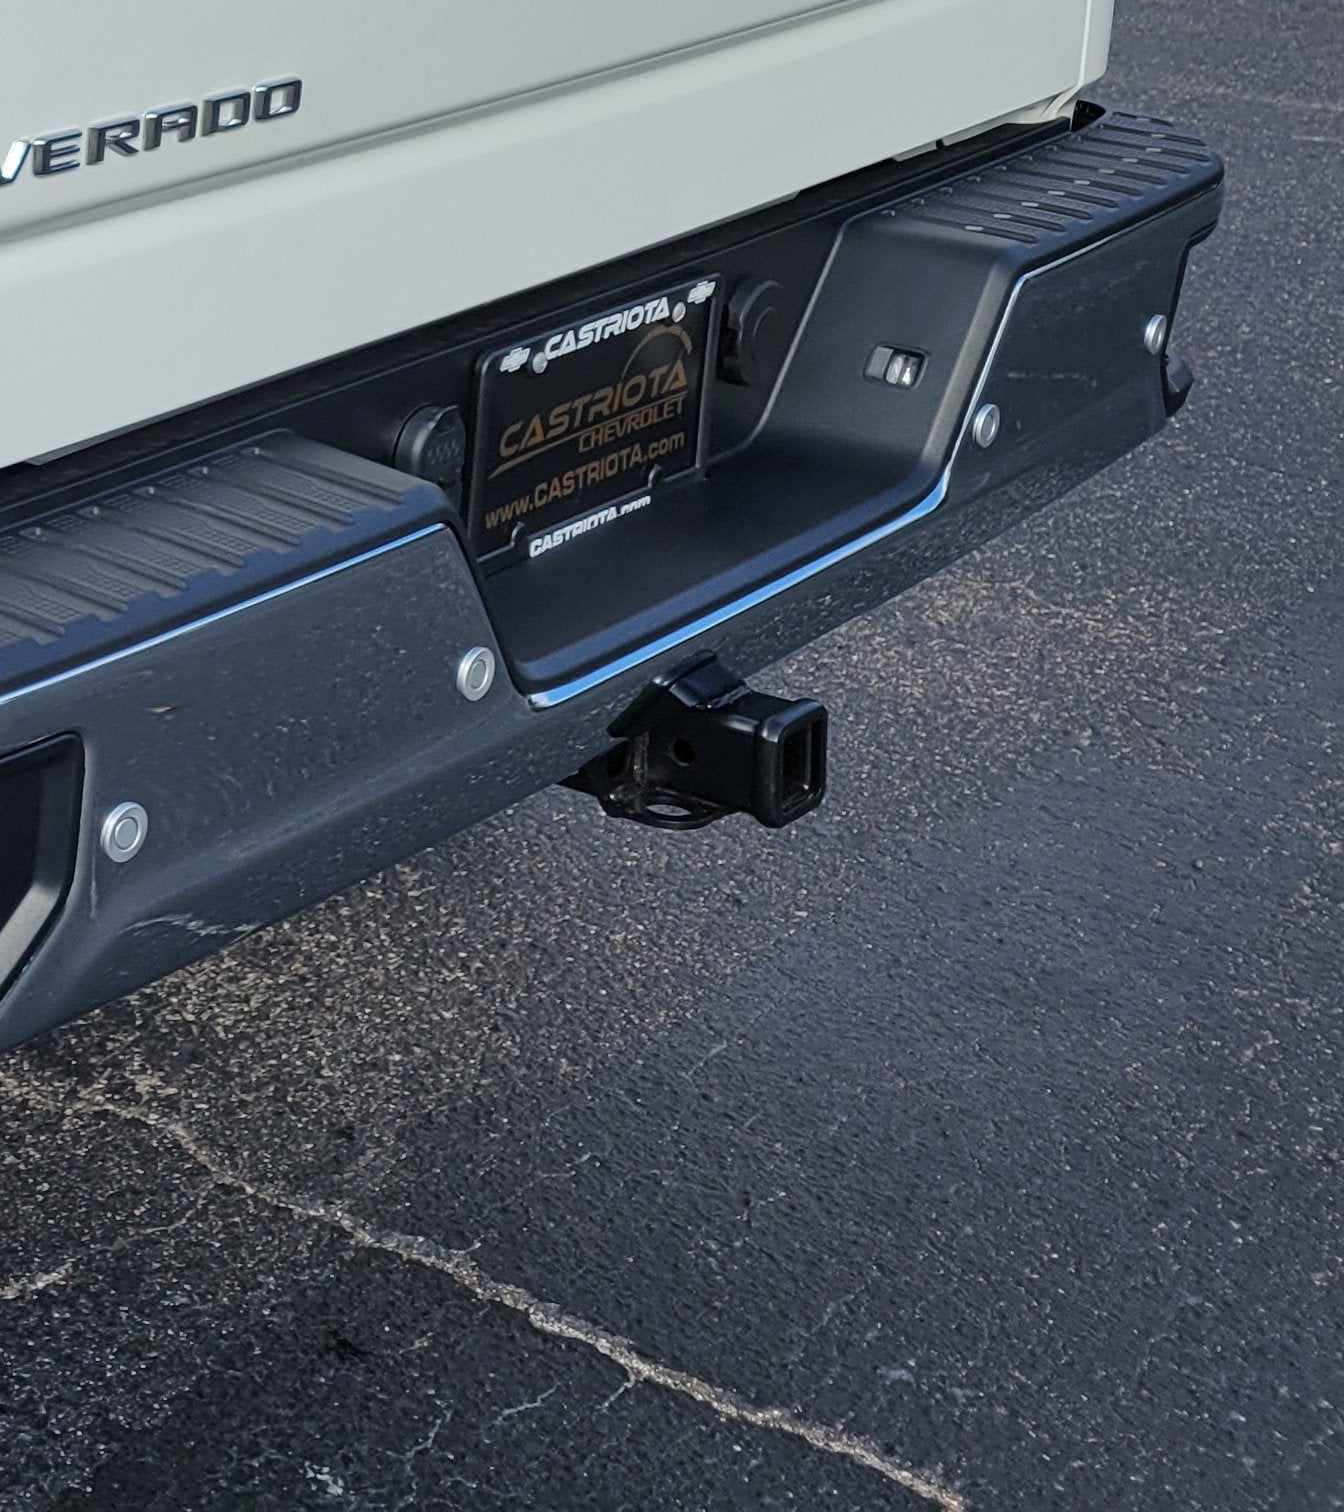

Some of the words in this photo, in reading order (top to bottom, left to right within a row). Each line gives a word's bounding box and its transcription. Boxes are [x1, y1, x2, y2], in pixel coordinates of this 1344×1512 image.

[544, 296, 670, 361] CASTRIOTA
[498, 361, 688, 459] CASTRIOTA
[577, 394, 687, 454] CHEVROLET
[484, 431, 686, 530] www.CASTRIOTA.com
